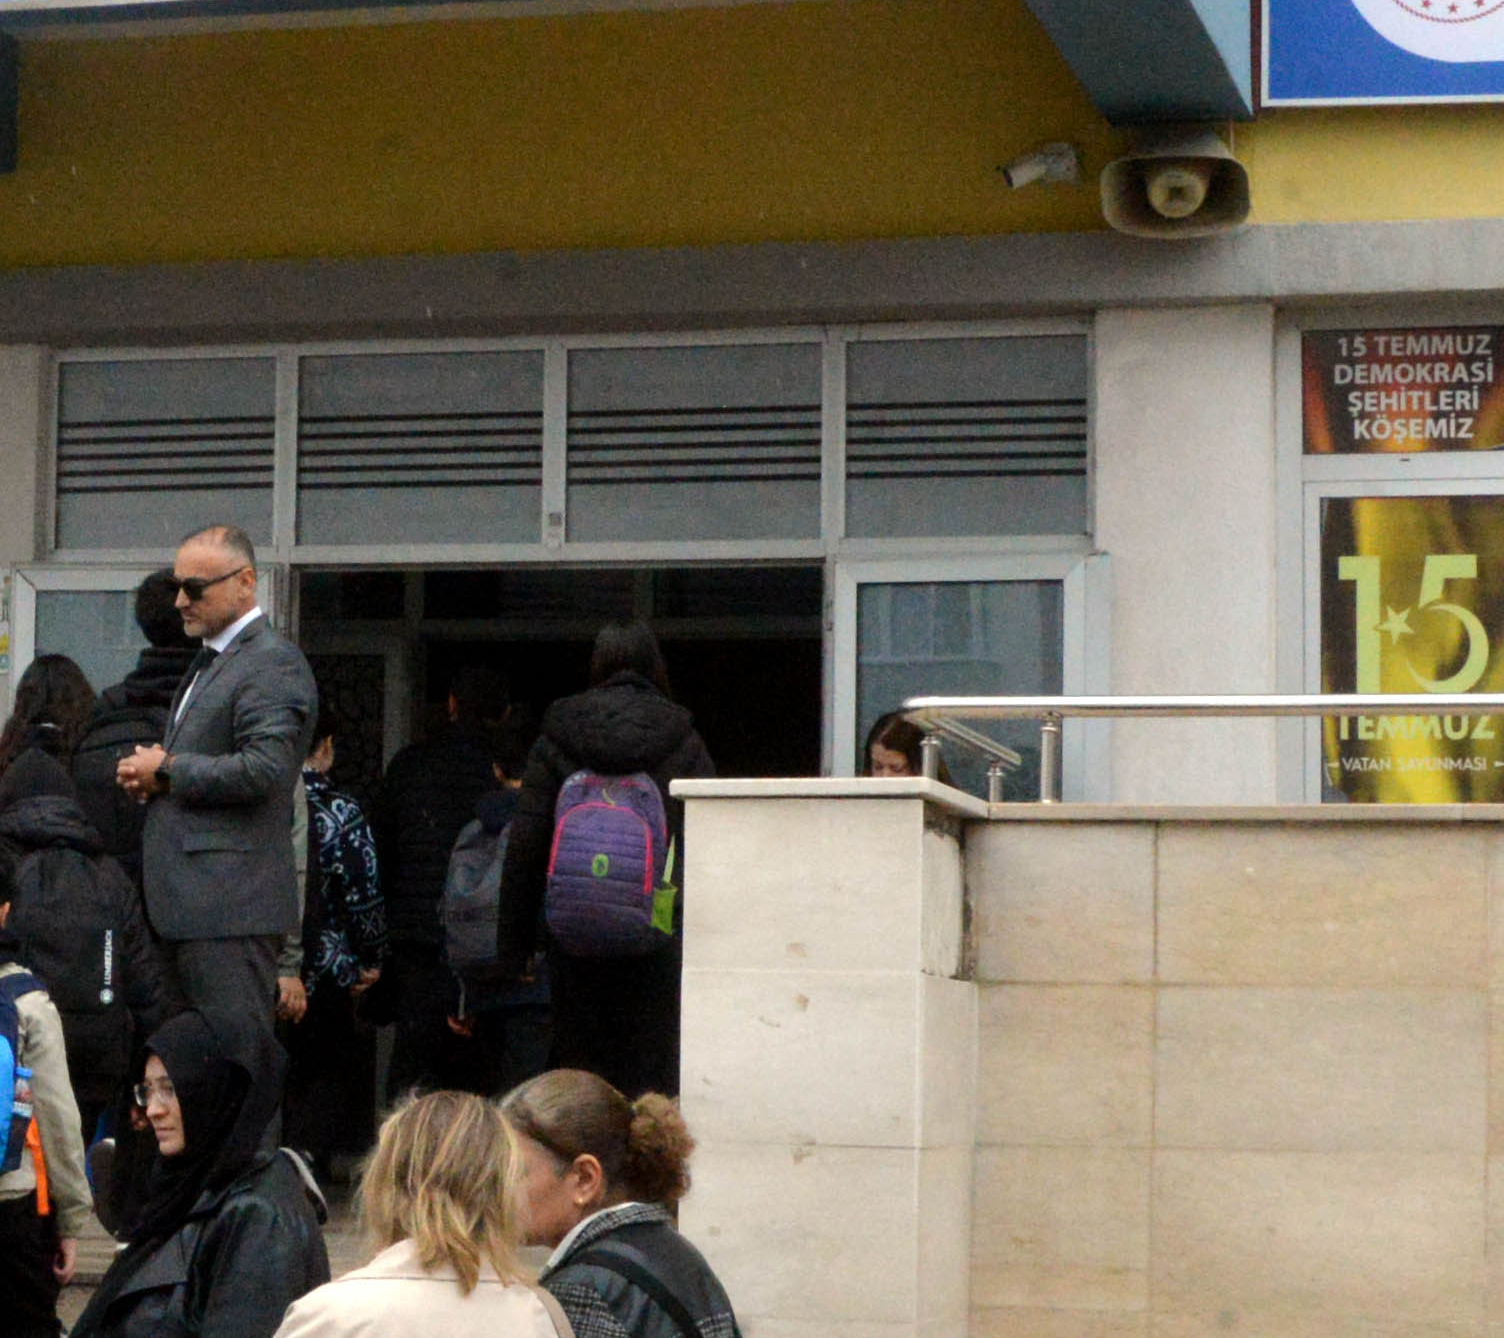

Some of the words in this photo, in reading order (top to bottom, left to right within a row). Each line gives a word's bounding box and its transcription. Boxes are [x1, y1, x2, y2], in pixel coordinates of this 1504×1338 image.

[1338, 335, 1368, 358] 15
[1373, 333, 1492, 358] TEMMUZ
[1333, 357, 1494, 386] DEMOKRASİ
[1347, 385, 1479, 418] ŞEHİTLERİ
[1353, 412, 1474, 447] KÖŞEMİZ
[1341, 756, 1391, 772] VATAN
